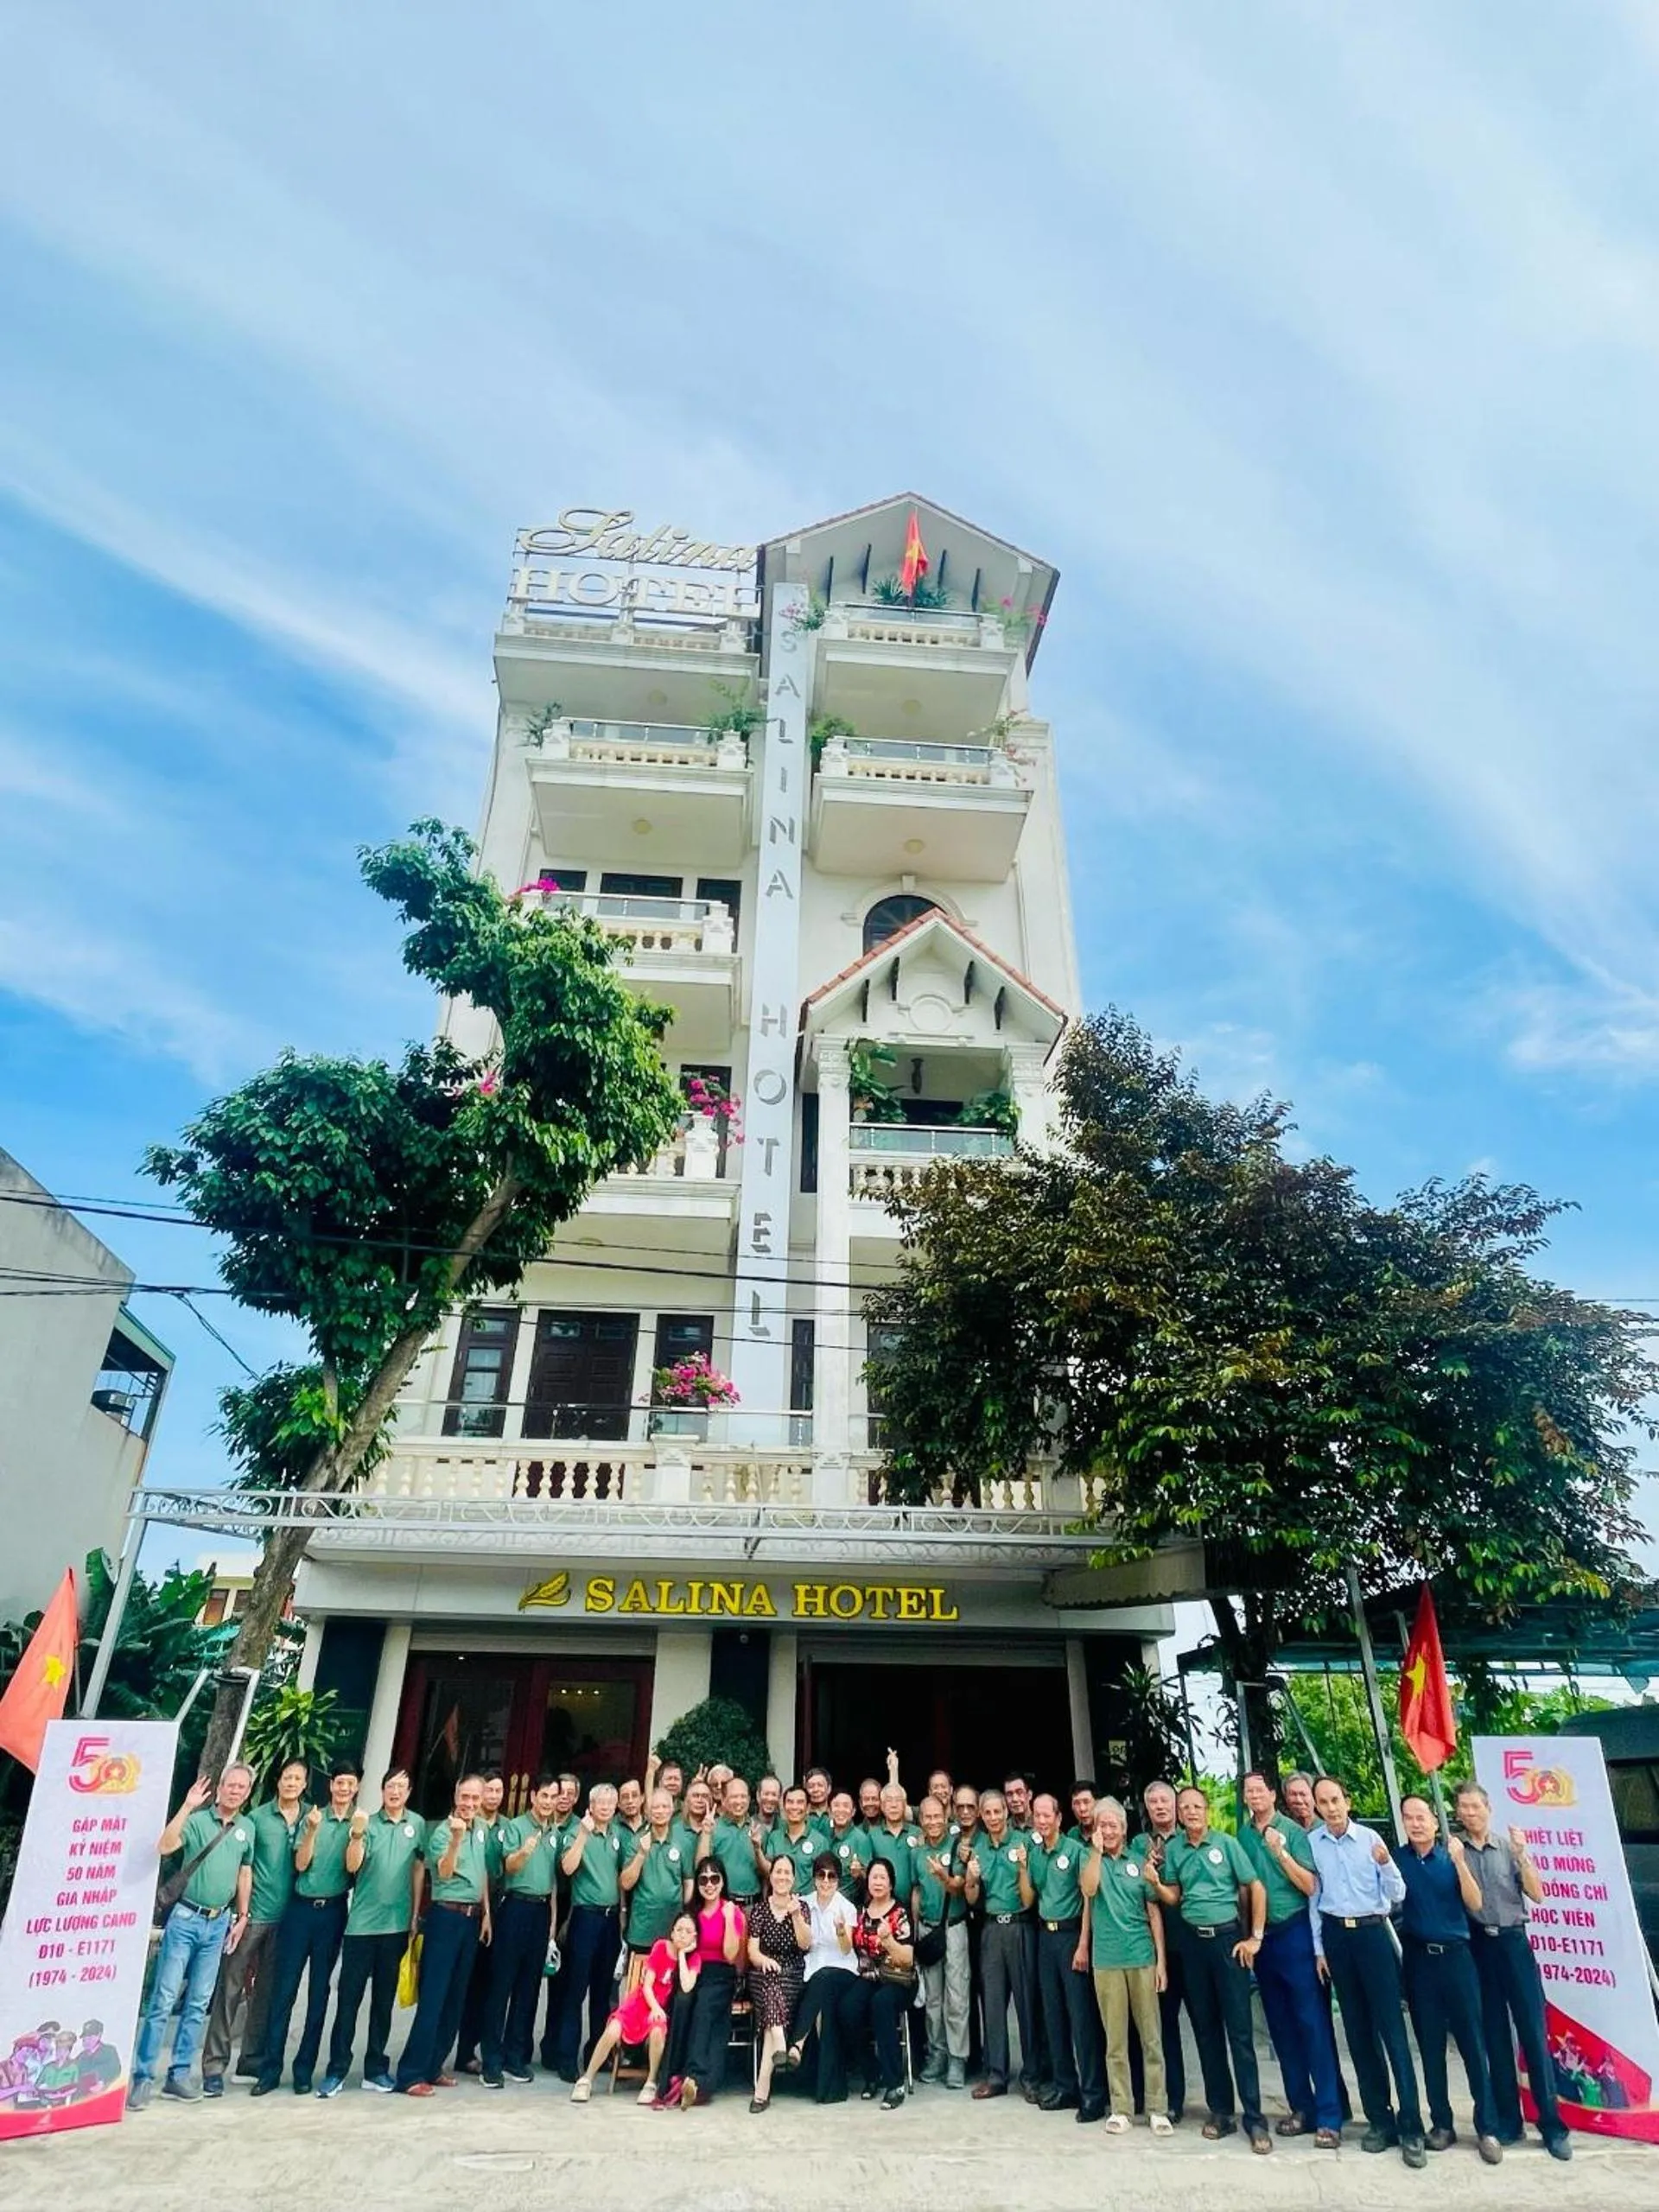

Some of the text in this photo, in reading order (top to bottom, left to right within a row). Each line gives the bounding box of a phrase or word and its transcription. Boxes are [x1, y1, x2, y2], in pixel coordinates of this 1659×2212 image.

[518, 509, 759, 572] Salina
[512, 566, 761, 619] HOTEL
[748, 630, 801, 1337] SALINA HOTEL
[584, 1576, 960, 1621] SALINA HOTEL
[1524, 1827, 1553, 1847] HIỆT
[67, 1866, 83, 1881] 50
[56, 1891, 78, 1907] GIA
[103, 1912, 137, 1929] CAND
[1531, 1908, 1559, 1928] HỌC
[78, 1939, 115, 1955] E1171
[29, 1969, 67, 1988] (1974
[79, 1965, 118, 1982] 2024)
